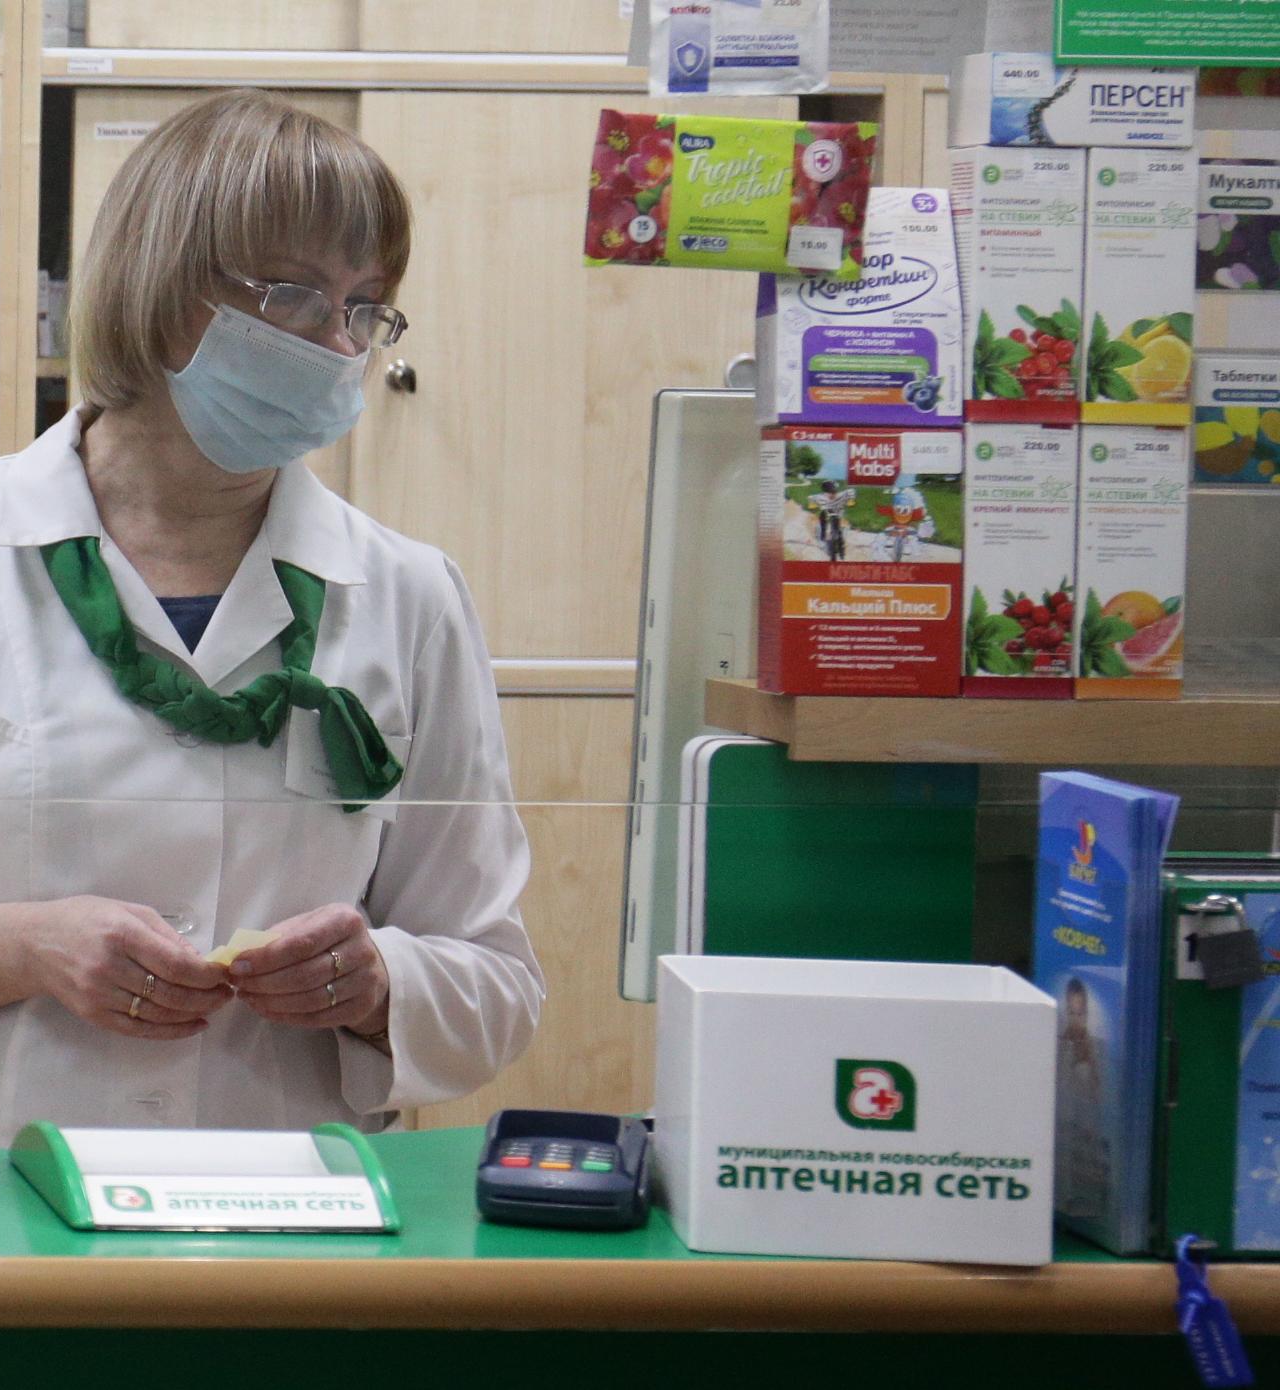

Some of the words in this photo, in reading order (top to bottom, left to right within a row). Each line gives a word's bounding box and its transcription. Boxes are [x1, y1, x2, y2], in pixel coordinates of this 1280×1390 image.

[1090, 84, 1185, 108] ПЕРСЕН
[686, 149, 763, 184] Tropic
[701, 169, 785, 209] cocktail
[808, 268, 930, 301] Конфеткин
[846, 293, 893, 307] форте
[1211, 369, 1278, 383] Таблетки
[850, 442, 896, 461] Multi
[973, 489, 988, 499] НА
[990, 489, 1035, 499] СТЕВИИ
[1088, 491, 1102, 500] НА
[1104, 490, 1147, 501] СТЕВИИ
[806, 599, 885, 617] Кальций
[889, 599, 936, 615] Плюс
[717, 1144, 874, 1164] муниципальная
[879, 1151, 1032, 1172] новосибирская
[716, 1162, 922, 1197] аптечная
[935, 1174, 1031, 1201] сеть
[167, 1199, 298, 1212] аптечная
[306, 1198, 366, 1211] сеть
